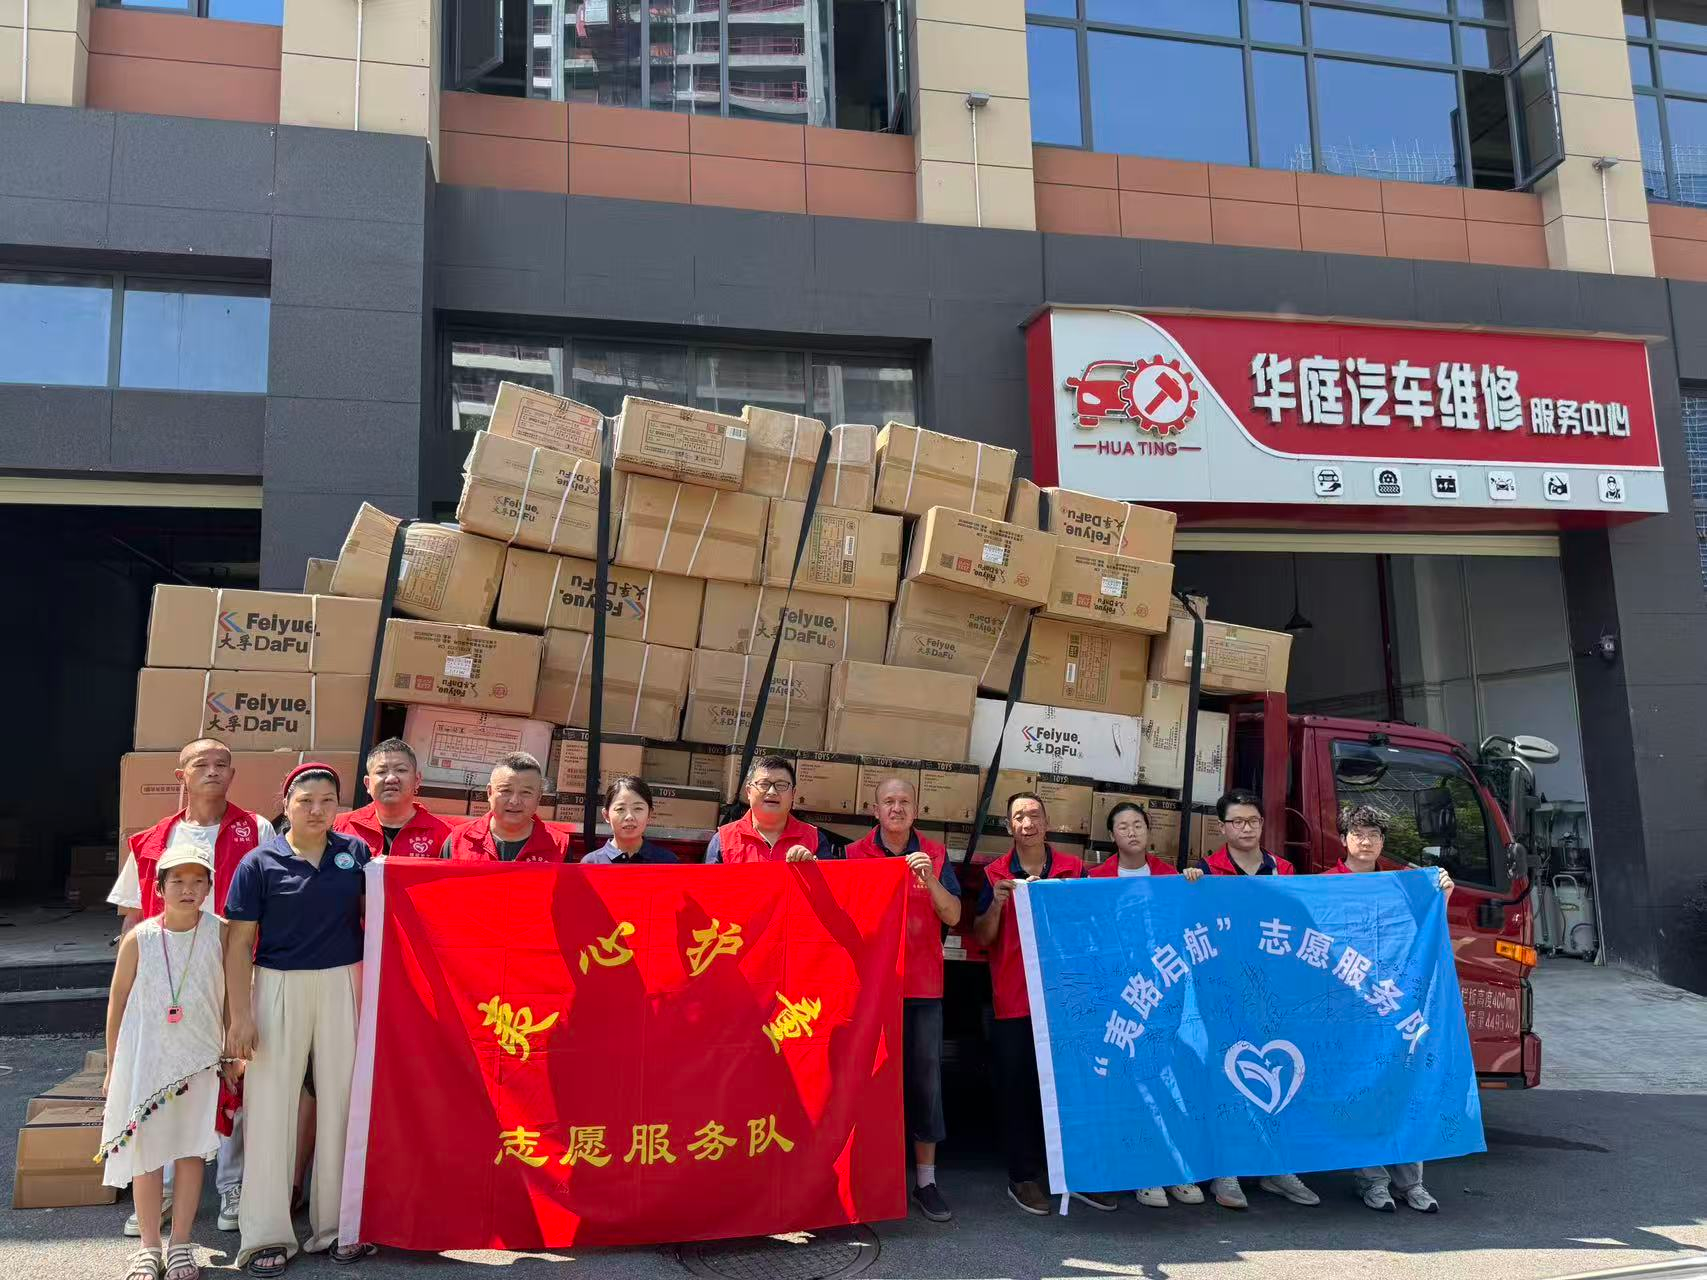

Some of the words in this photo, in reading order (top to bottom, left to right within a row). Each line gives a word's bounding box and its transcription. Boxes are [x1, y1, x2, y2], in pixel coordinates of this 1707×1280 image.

[1251, 353, 1523, 432] 华庭汽车维修
[1530, 398, 1630, 437] 服务中心
[1098, 440, 1134, 456] HUA
[1138, 440, 1178, 456] TING
[814, 752, 830, 761] TOYS
[937, 762, 953, 771] TOYS
[1053, 775, 1069, 783] TOYS
[659, 788, 676, 797] TOYS
[494, 1114, 795, 1168] 志愿服务队
